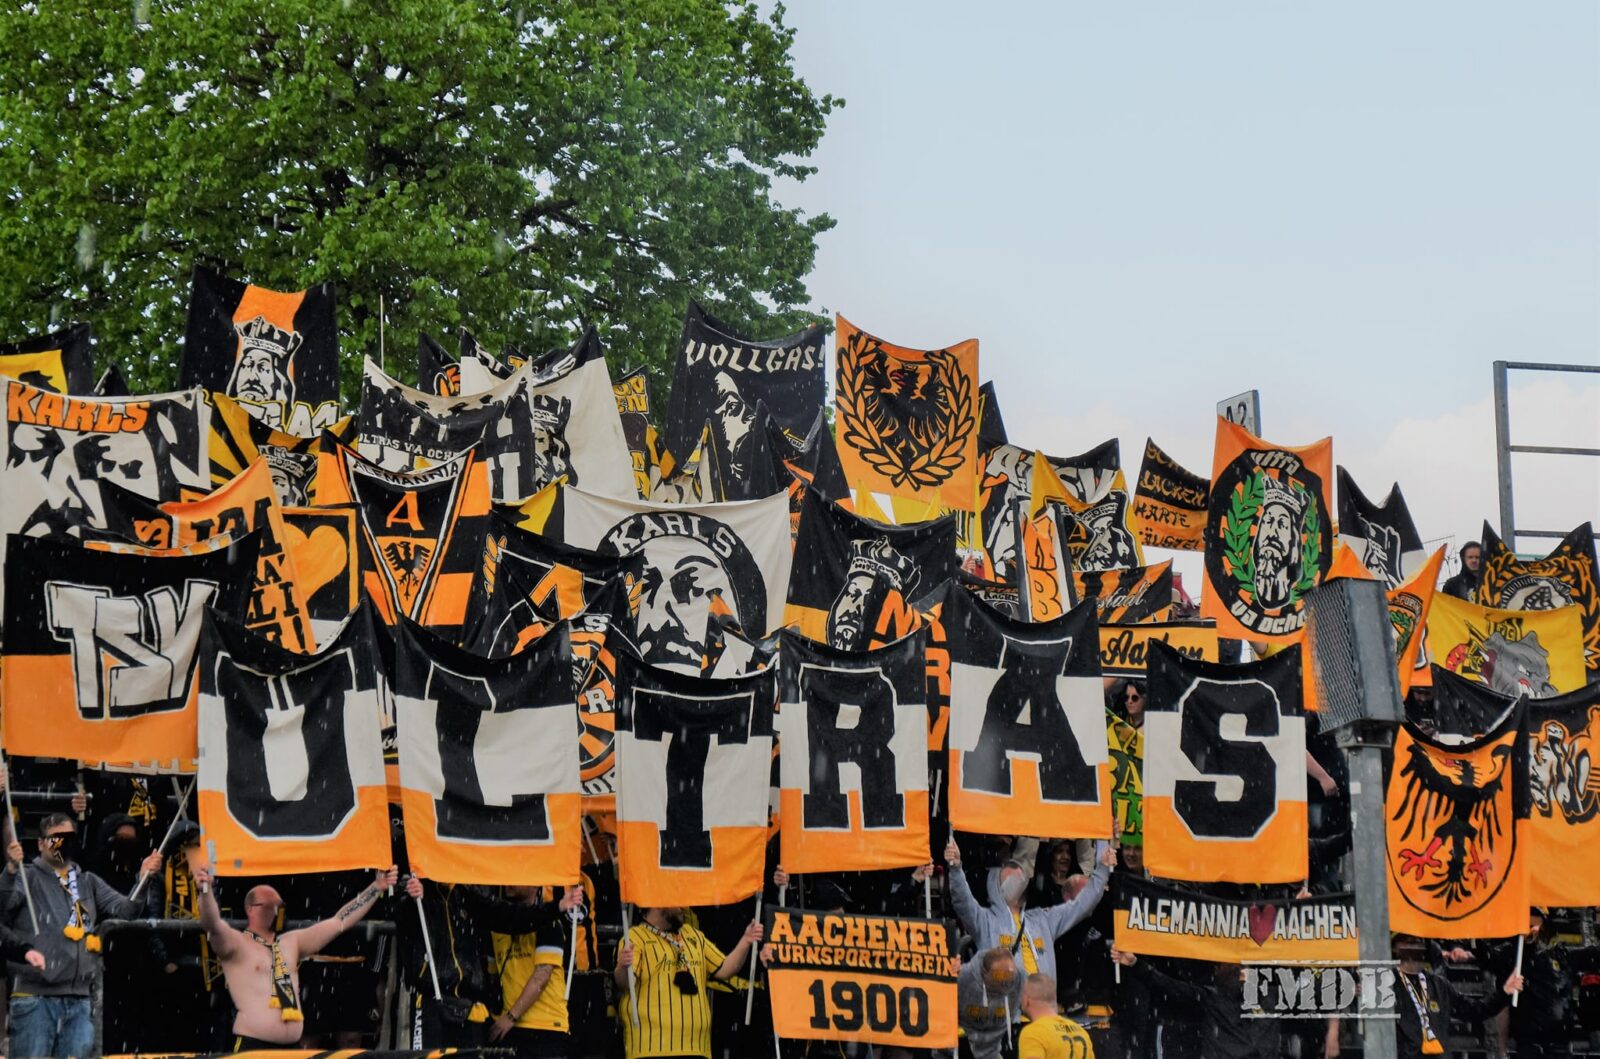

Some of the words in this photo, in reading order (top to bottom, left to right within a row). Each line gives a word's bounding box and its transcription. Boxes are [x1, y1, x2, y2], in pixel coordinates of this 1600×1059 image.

[6, 380, 151, 434] KARLS
[609, 511, 735, 559] KARLS
[770, 912, 949, 956] AACHENER
[1127, 897, 1251, 939] ALEMANNIA
[1273, 904, 1357, 941] AACHEN
[766, 943, 957, 977] TURNSPORTVEREIN
[808, 979, 929, 1037] 1900
